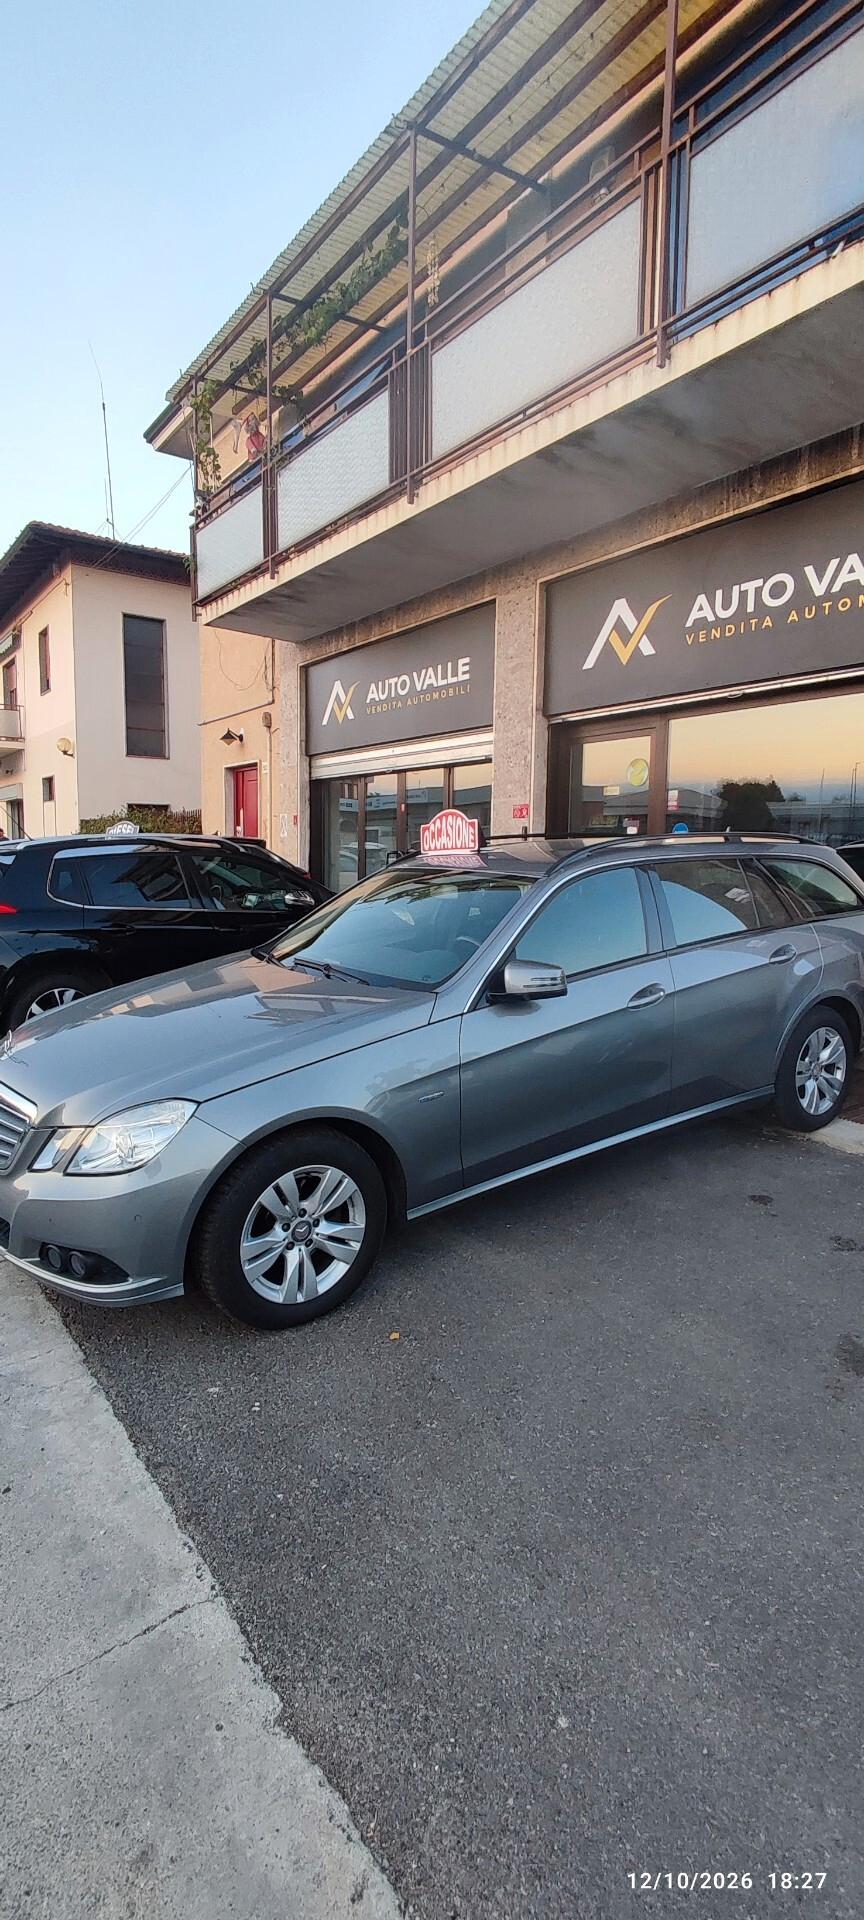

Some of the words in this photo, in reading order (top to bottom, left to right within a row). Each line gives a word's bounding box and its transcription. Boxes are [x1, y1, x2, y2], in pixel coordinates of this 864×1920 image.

[685, 573, 794, 628] AUTO
[685, 615, 774, 645] VENDITA
[366, 675, 410, 703] AUTO
[412, 656, 470, 691] VALLE
[366, 701, 402, 715] VENDITA
[407, 685, 471, 706] AUTOMOBILI
[424, 815, 475, 851] OCCASIONE
